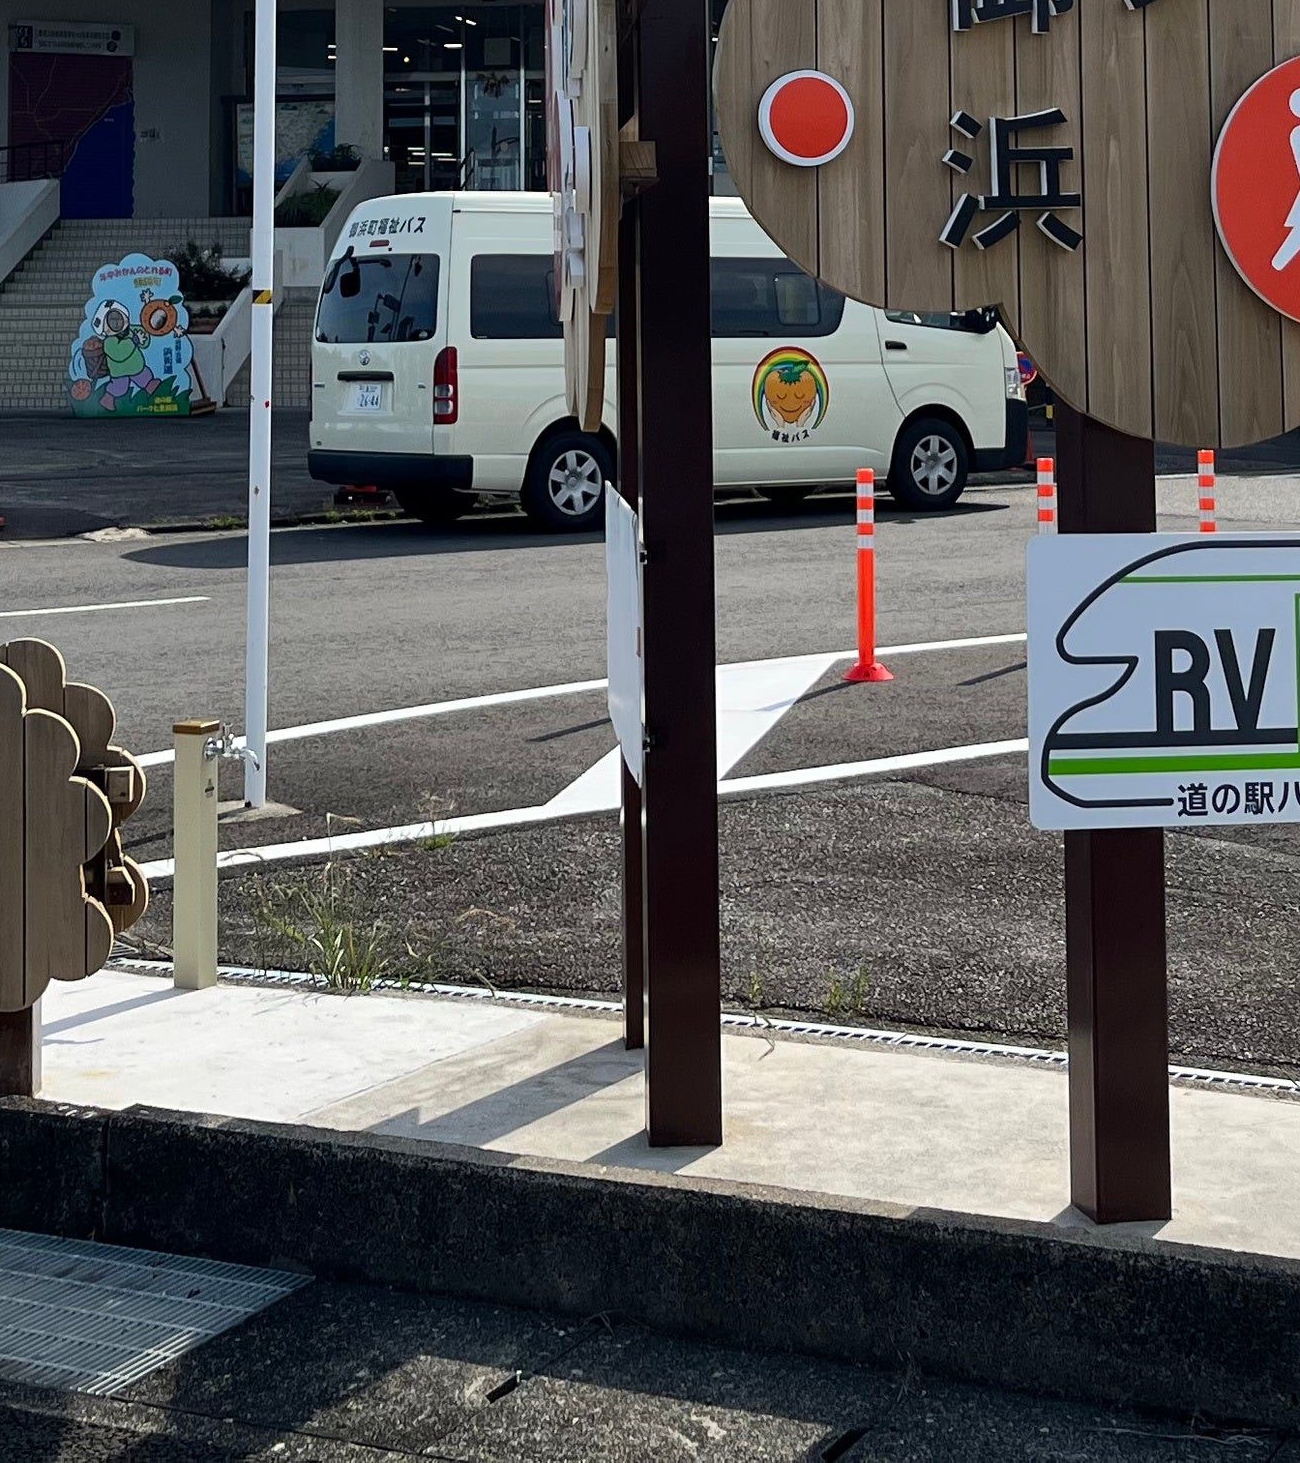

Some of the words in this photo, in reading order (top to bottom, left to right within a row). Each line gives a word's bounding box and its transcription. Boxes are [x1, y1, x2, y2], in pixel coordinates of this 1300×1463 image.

[349, 217, 426, 237] 御浜町福祉バス
[1154, 628, 1276, 732] RV
